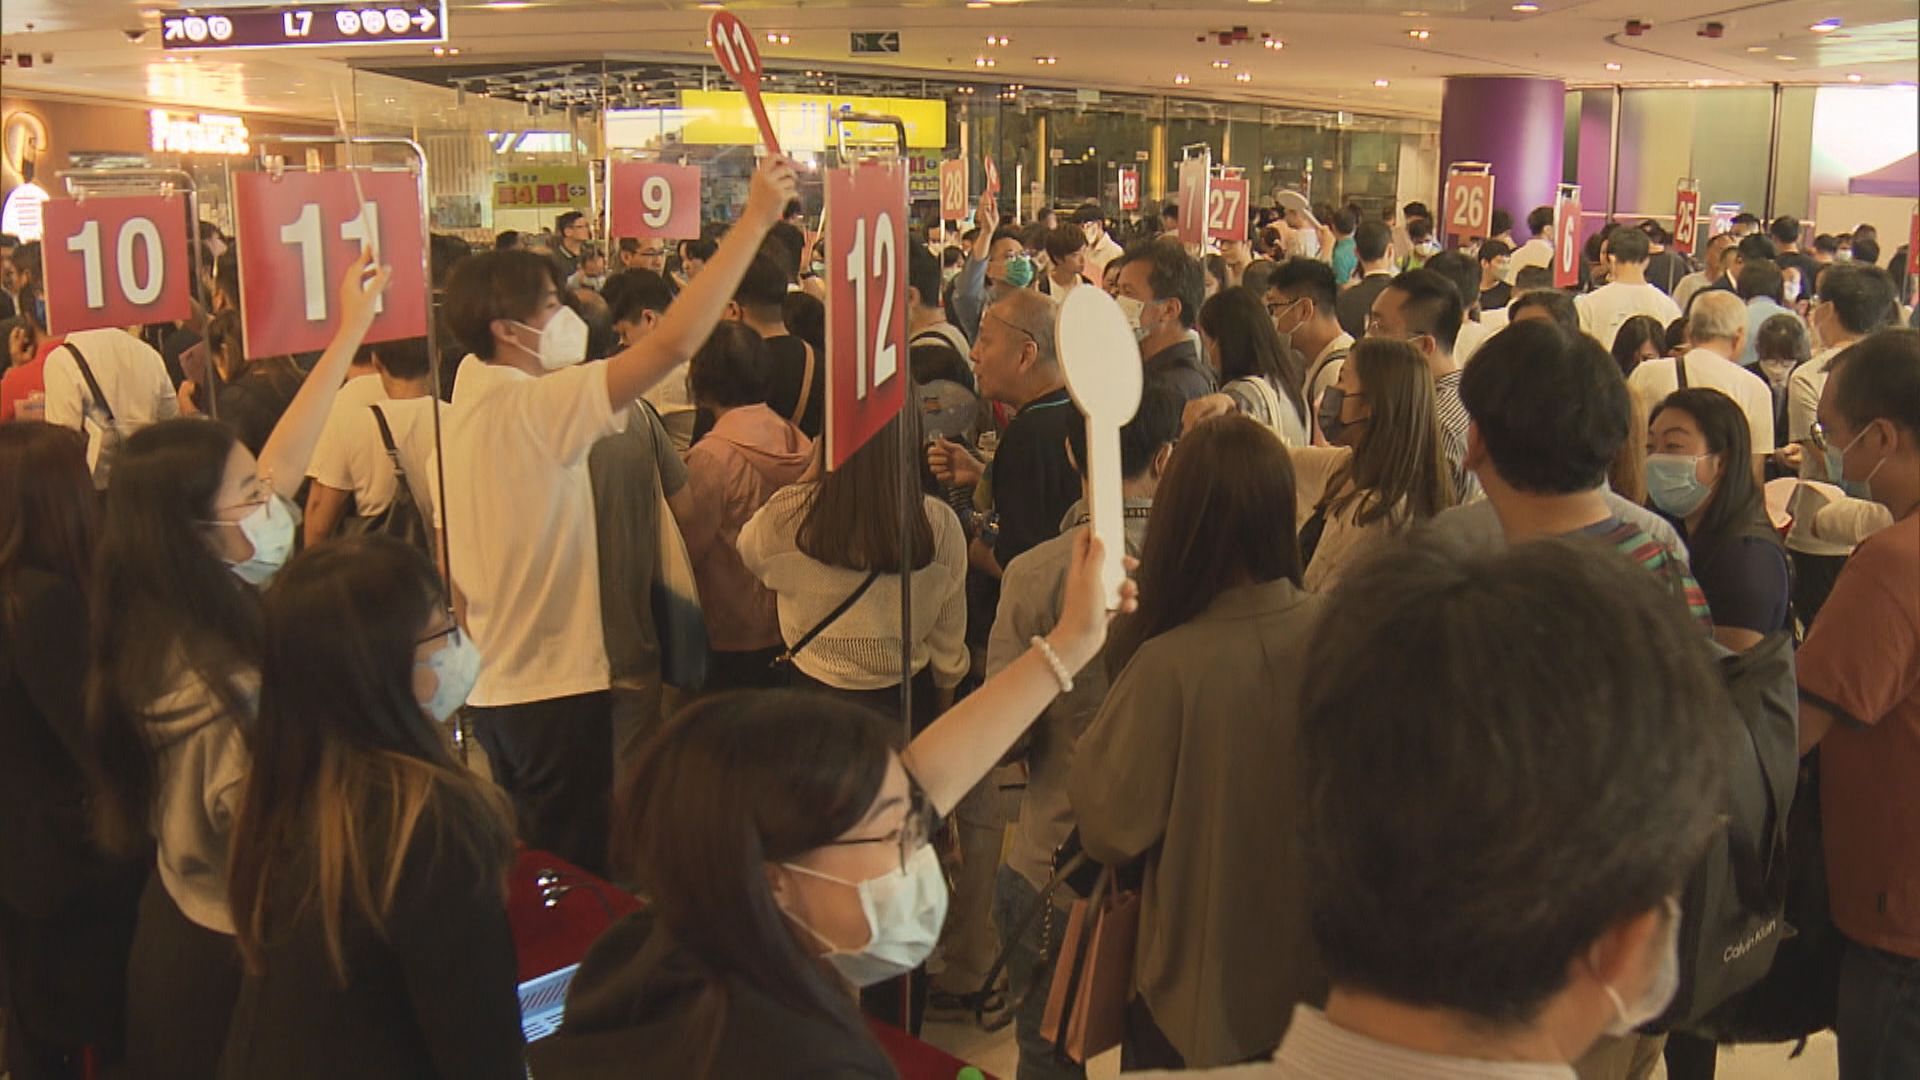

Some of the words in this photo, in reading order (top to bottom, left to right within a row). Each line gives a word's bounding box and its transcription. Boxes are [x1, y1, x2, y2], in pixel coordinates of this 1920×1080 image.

[283, 10, 312, 37] L7
[716, 22, 756, 74] 11
[641, 175, 672, 229] 9
[945, 169, 963, 211] 28
[1123, 177, 1137, 204] 33
[1186, 176, 1197, 230] 7
[1209, 188, 1241, 230] 27
[1453, 185, 1485, 228] 26
[1562, 215, 1575, 273] 6
[1676, 200, 1694, 244] 25
[66, 216, 164, 309] 10
[280, 201, 383, 321] 11
[846, 211, 897, 401] 12
[1723, 934, 1754, 962] Calvin
[1754, 918, 1776, 944] Klein
